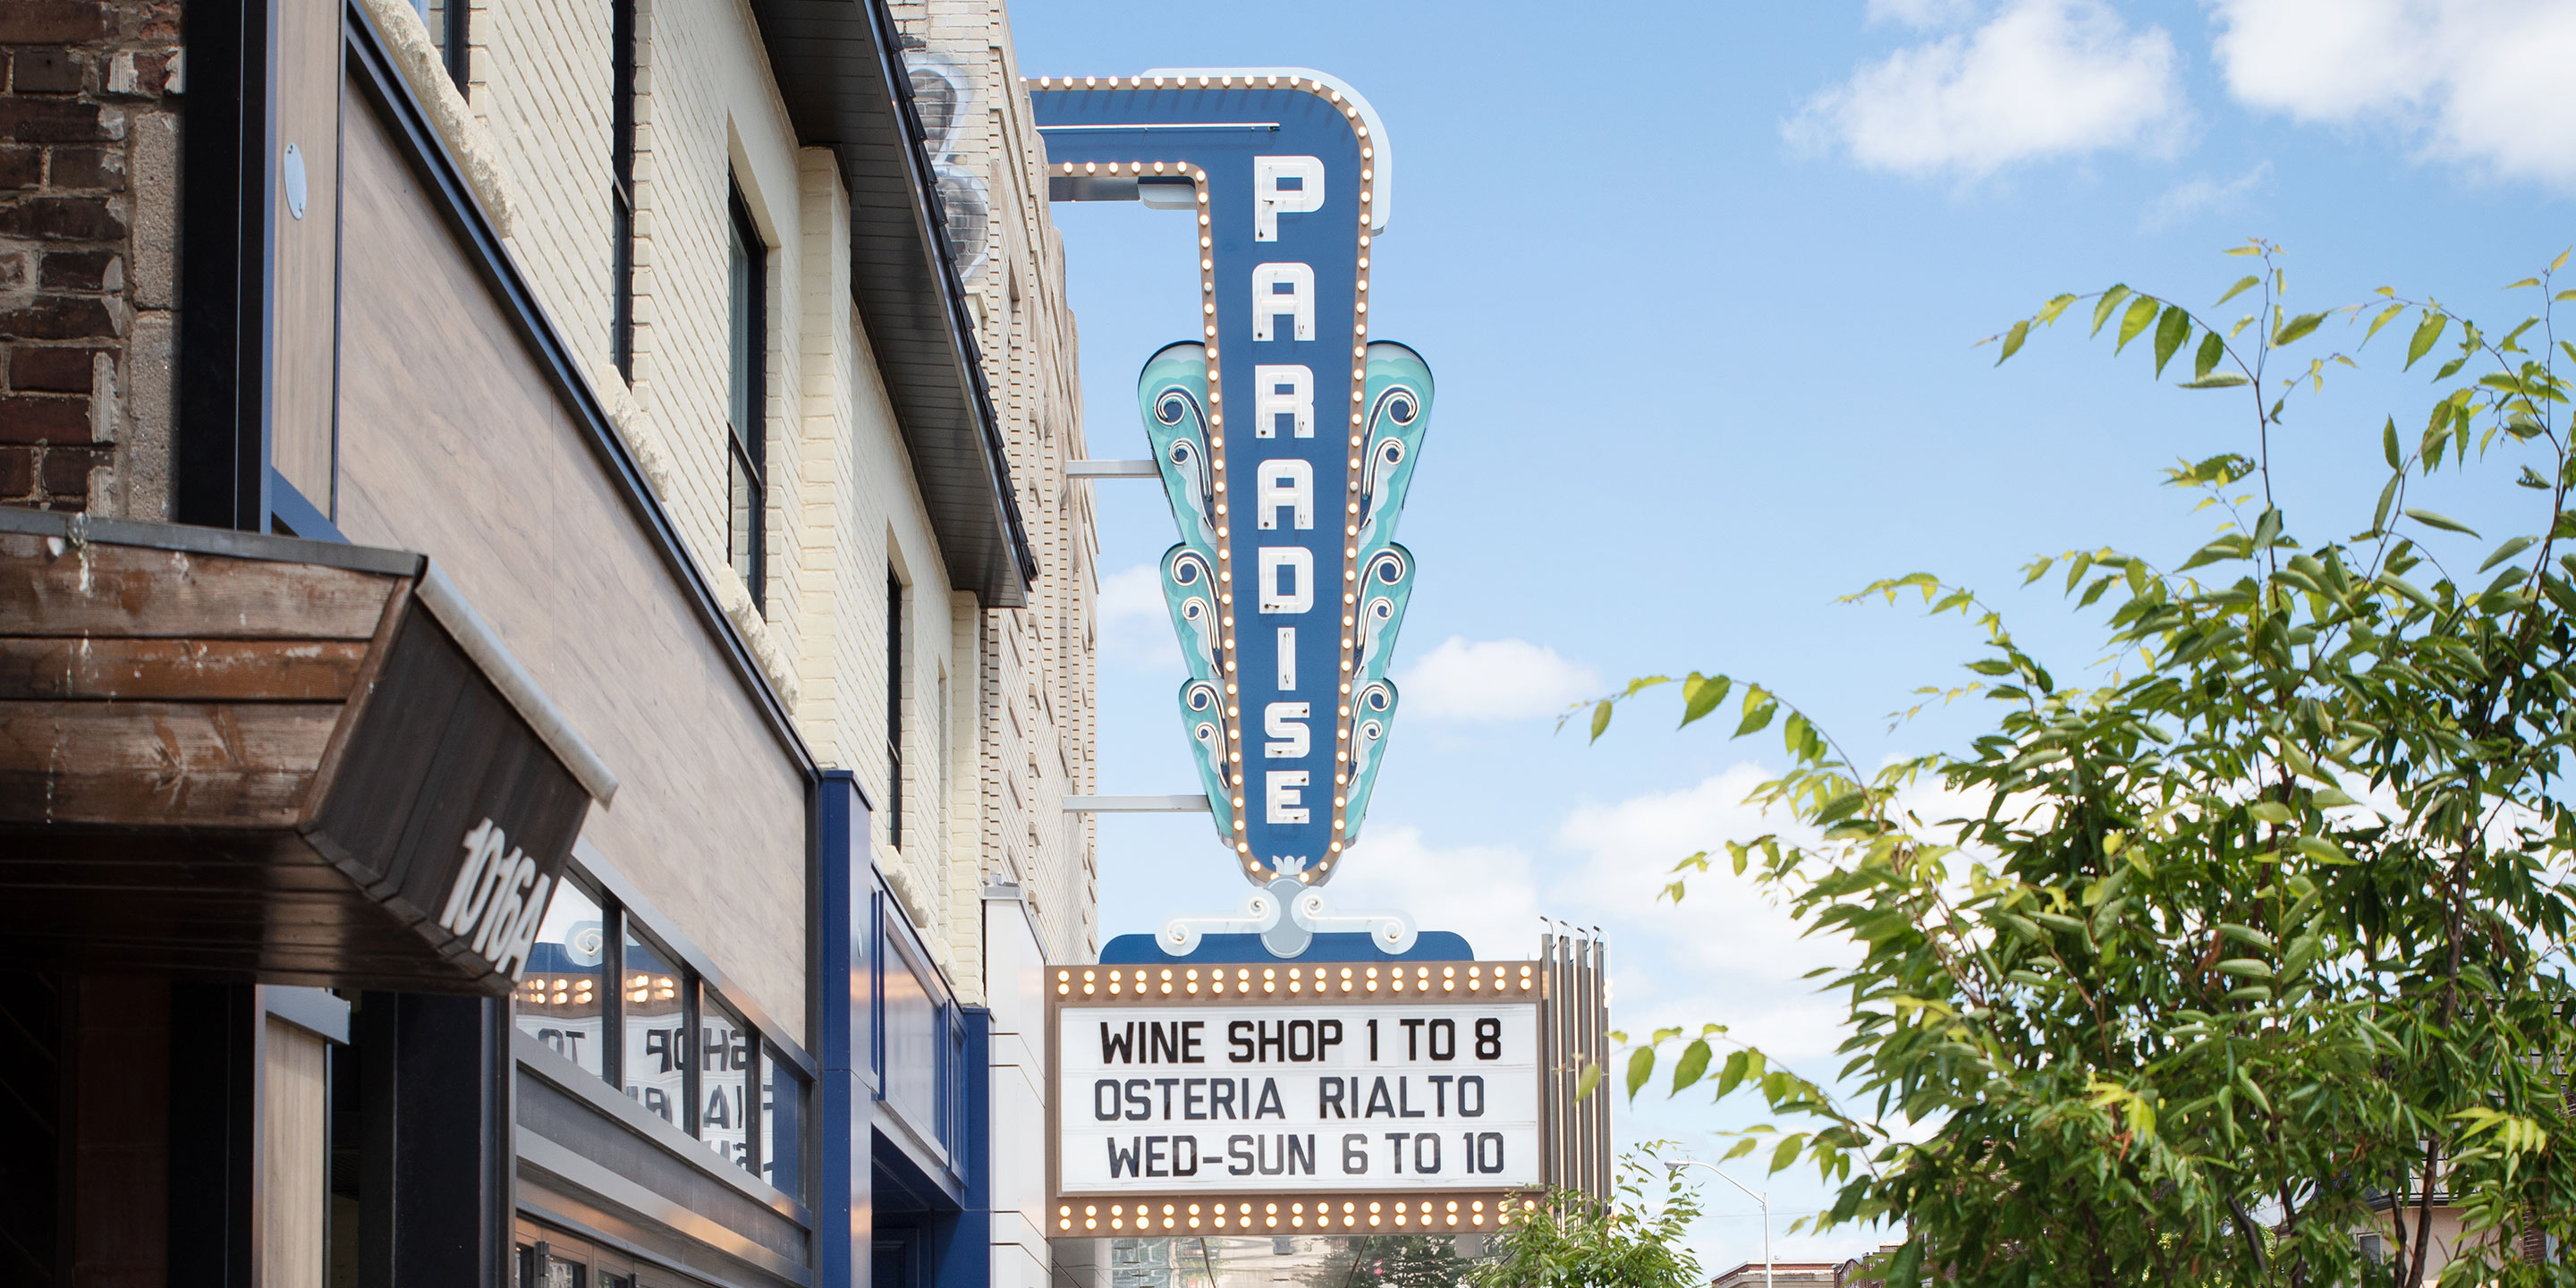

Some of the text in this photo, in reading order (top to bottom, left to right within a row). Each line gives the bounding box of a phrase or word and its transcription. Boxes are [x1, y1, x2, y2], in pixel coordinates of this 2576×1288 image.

[1252, 156, 1326, 825] PARADISE
[439, 817, 551, 983] 1016A
[1100, 1017, 1502, 1064] WINE SHOP 1 TO 8
[1094, 1075, 1485, 1121] OSTERIA RIALTO
[1106, 1131, 1504, 1179] WED-SUN 6 TO 10
